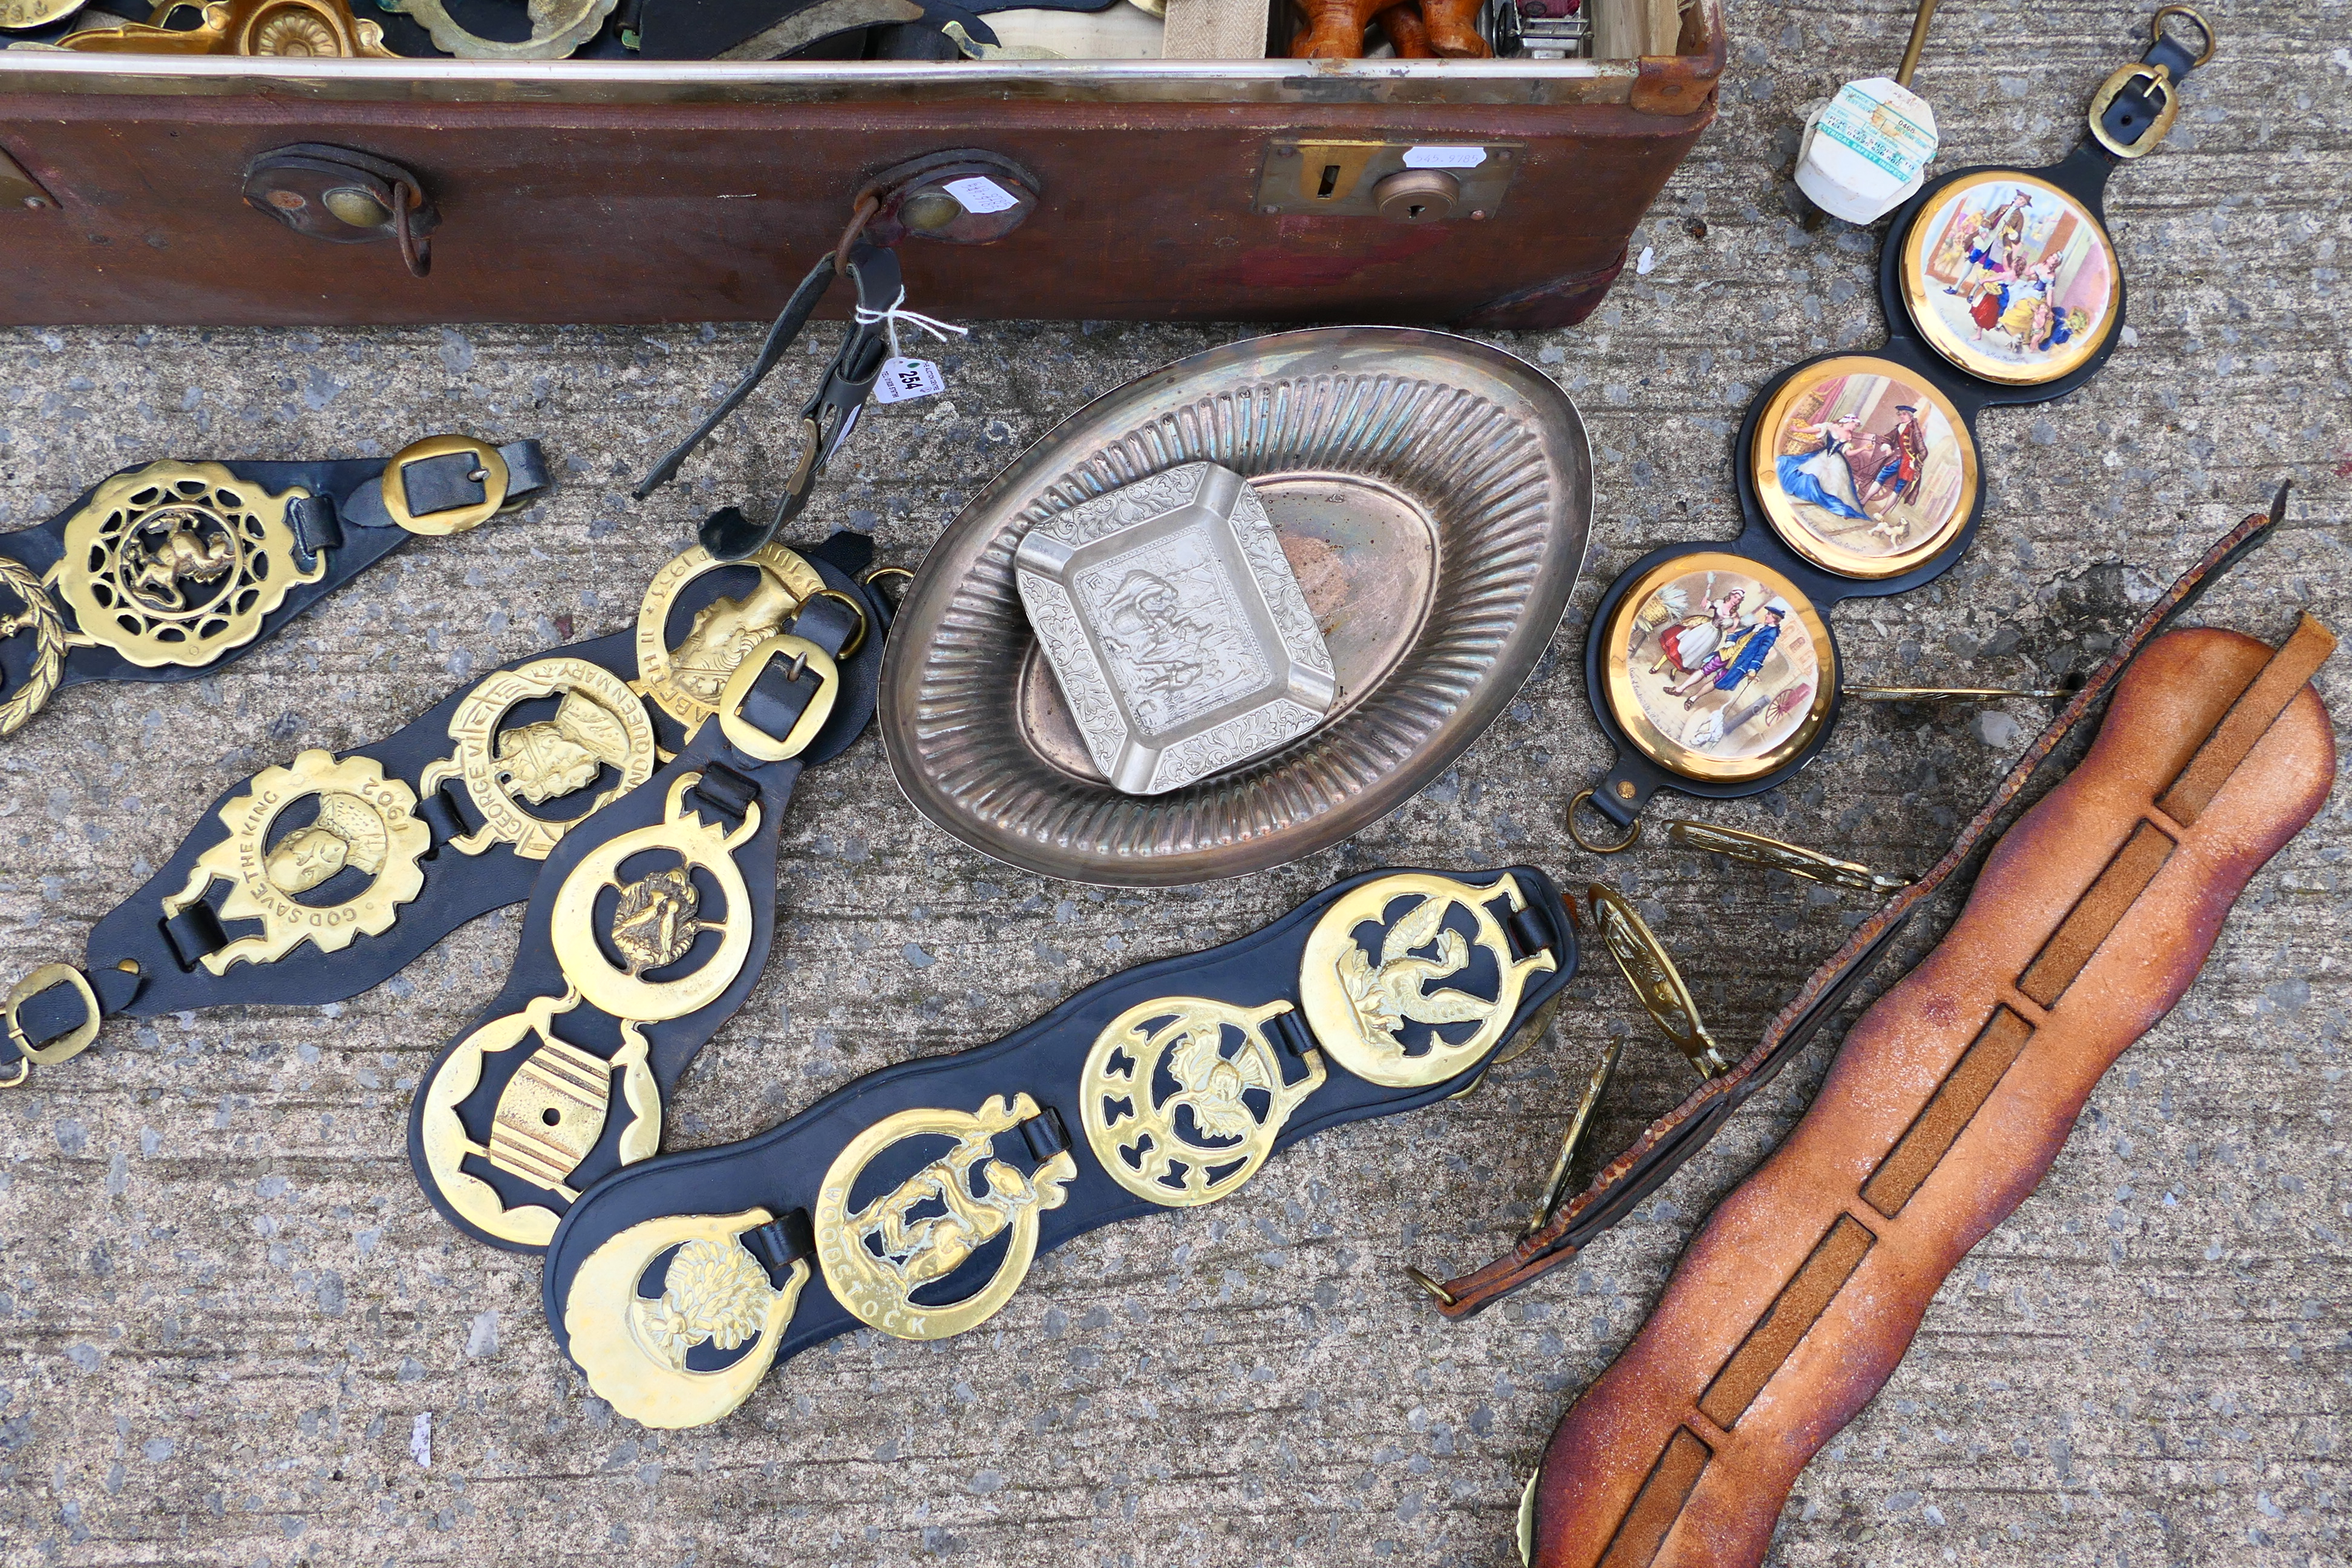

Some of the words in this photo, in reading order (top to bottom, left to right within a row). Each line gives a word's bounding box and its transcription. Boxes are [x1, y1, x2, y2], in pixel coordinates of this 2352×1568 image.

[1851, 142, 1878, 163] SAFETY
[898, 371, 924, 390] 254
[559, 662, 613, 693] MARY
[612, 689, 651, 754] QUEEN
[241, 789, 281, 837] KING
[362, 776, 410, 832] 1902
[468, 764, 523, 835] GEORGE
[240, 842, 260, 884] THE
[250, 882, 304, 924] SAVE
[310, 907, 357, 927] GOD
[818, 1186, 926, 1335] WOODSTOCK
